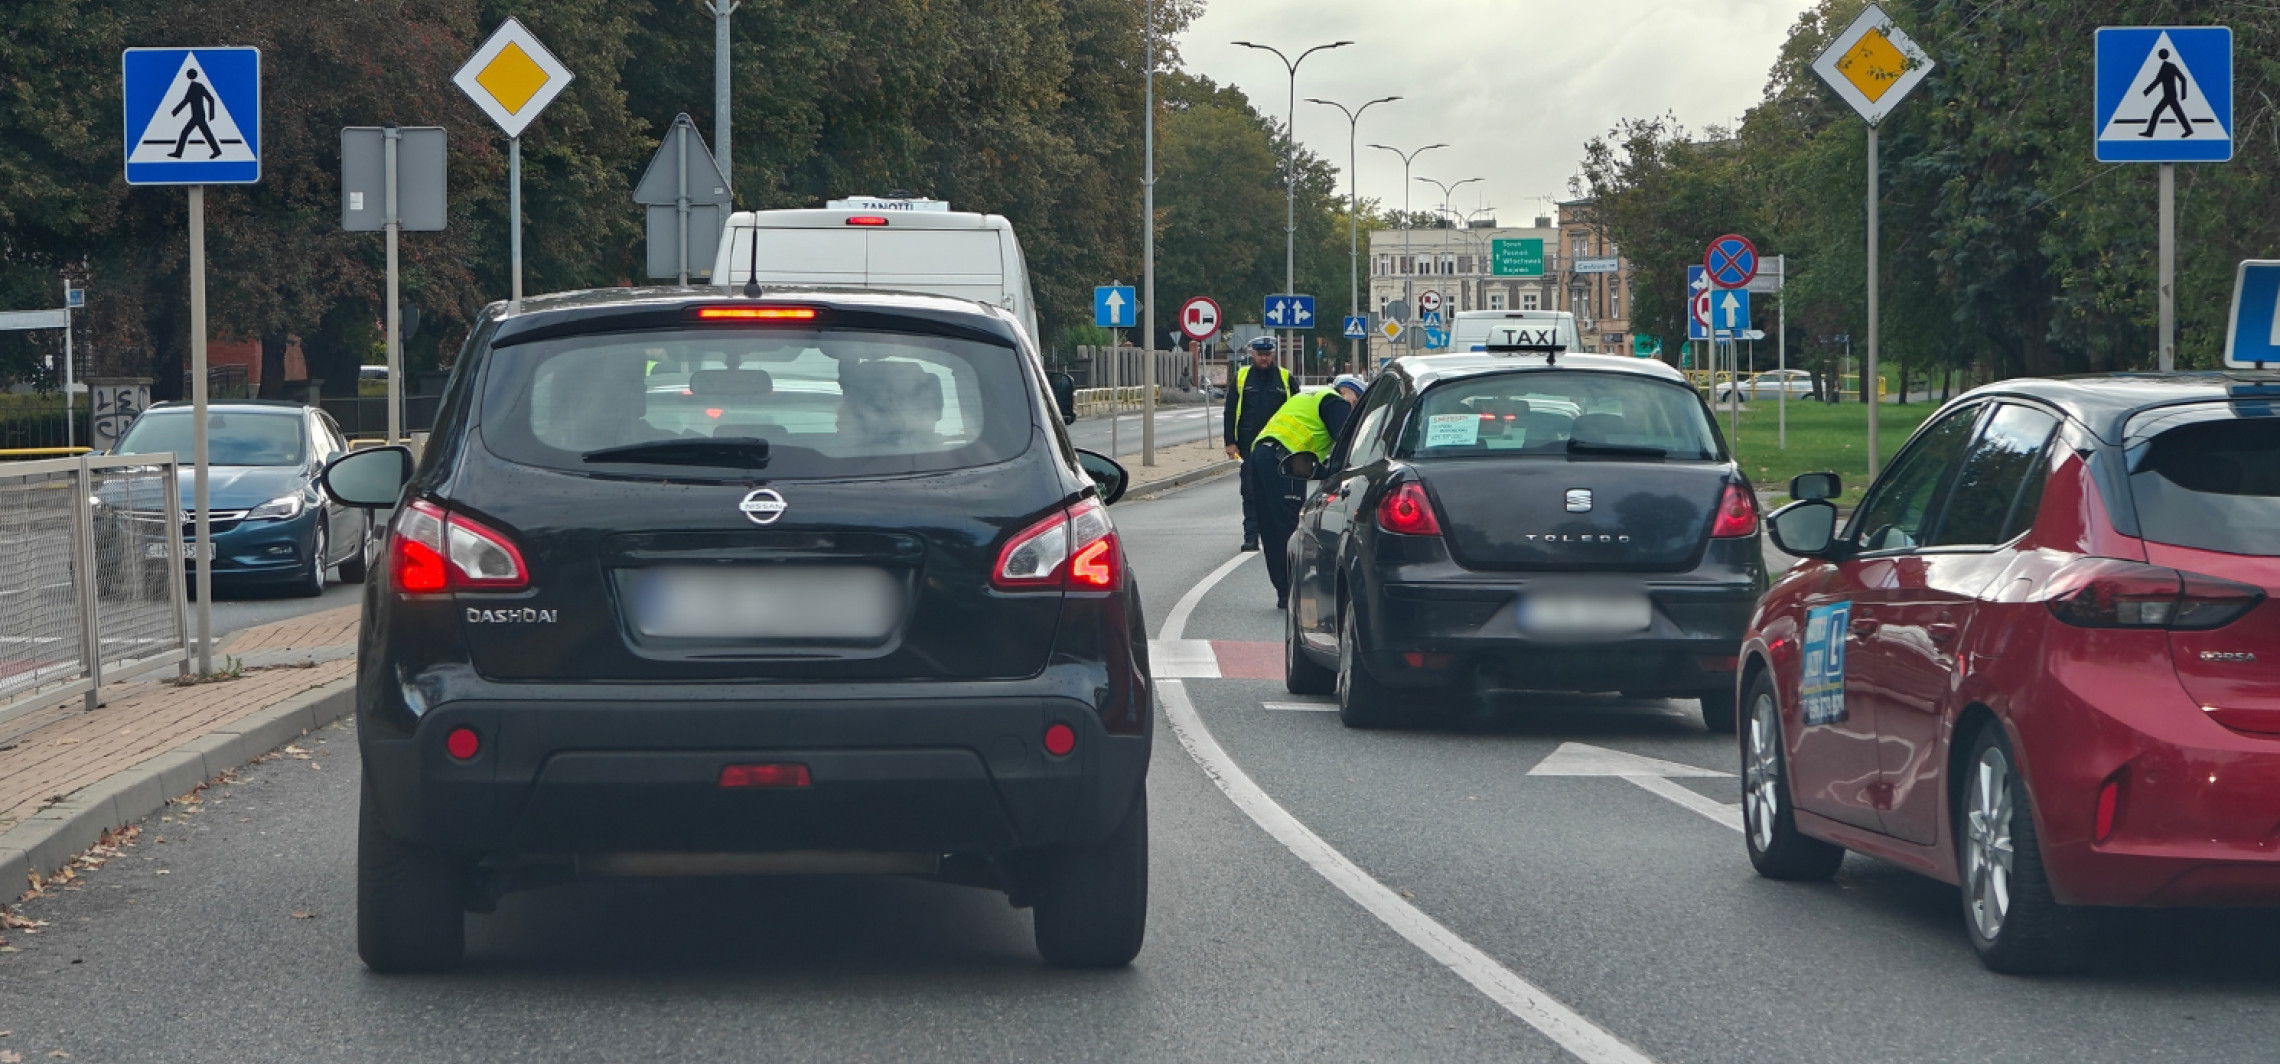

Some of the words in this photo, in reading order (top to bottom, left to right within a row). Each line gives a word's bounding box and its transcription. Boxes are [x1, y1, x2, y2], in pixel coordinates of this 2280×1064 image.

[1502, 329, 1556, 345] TAXI
[745, 502, 782, 510] NISSAN
[1525, 534, 1630, 543] TOLEDO
[2200, 651, 2257, 662] CORSA
